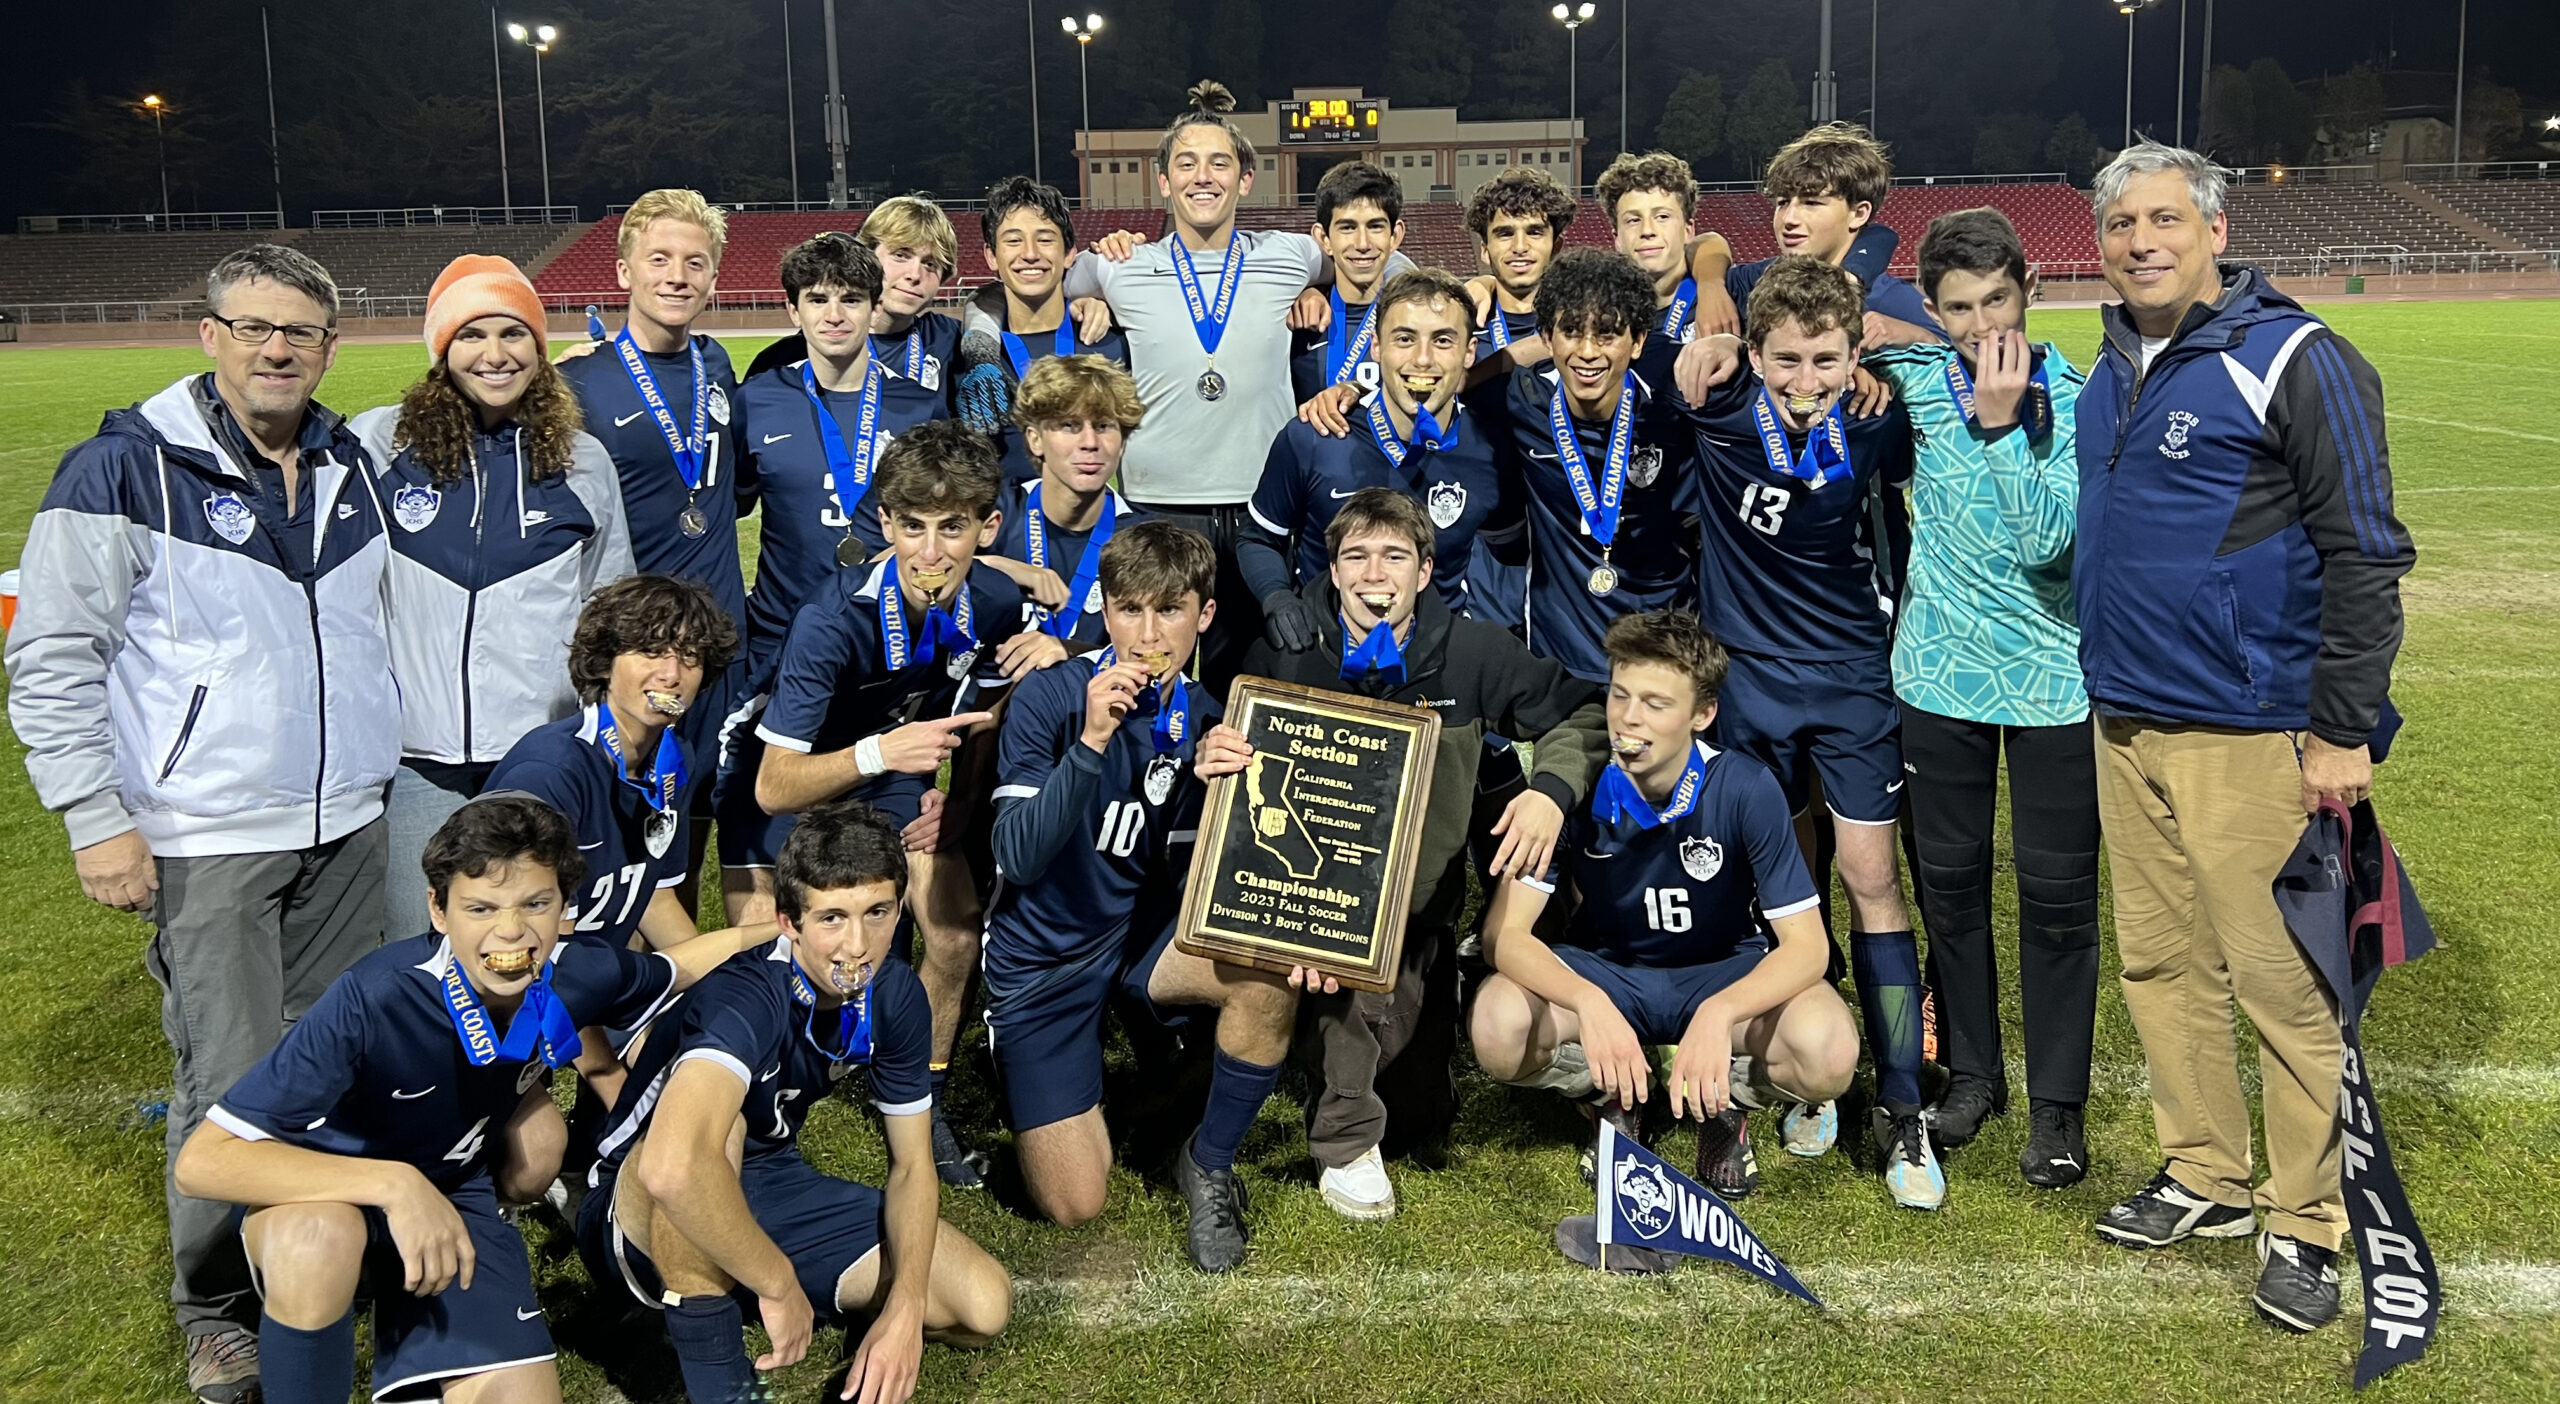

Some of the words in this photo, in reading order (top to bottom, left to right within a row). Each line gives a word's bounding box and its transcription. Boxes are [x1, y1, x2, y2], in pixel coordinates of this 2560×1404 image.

[1366, 109, 1378, 126] 0
[618, 339, 646, 376] NORTH
[637, 374, 664, 409] COAST
[654, 407, 685, 453] SECTION
[2167, 410, 2200, 427] JCHS
[859, 404, 876, 439] COAST
[853, 438, 871, 486] SECTION
[1556, 428, 1580, 464] COAST
[1568, 464, 1598, 512] SECTION
[1602, 388, 1633, 508] CHAMPIONSHIPS
[1766, 432, 1788, 467] COAST
[1739, 482, 1791, 536] 13
[883, 585, 903, 631] NORTH
[1267, 714, 1325, 744] North
[1333, 727, 1389, 752] Coast
[1288, 740, 1360, 767] Section
[1096, 800, 1146, 858] 10
[575, 862, 647, 932] 27
[1234, 870, 1361, 908] Championships
[1240, 891, 1276, 908] 2023
[1644, 887, 1693, 934] 16
[1262, 912, 1272, 926] 3
[460, 1008, 497, 1058] COAST
[442, 1115, 491, 1167] 4
[1628, 1208, 1663, 1230] JCHS
[1676, 1182, 1777, 1278] WOLVES
[2341, 1128, 2429, 1350] FIRST
